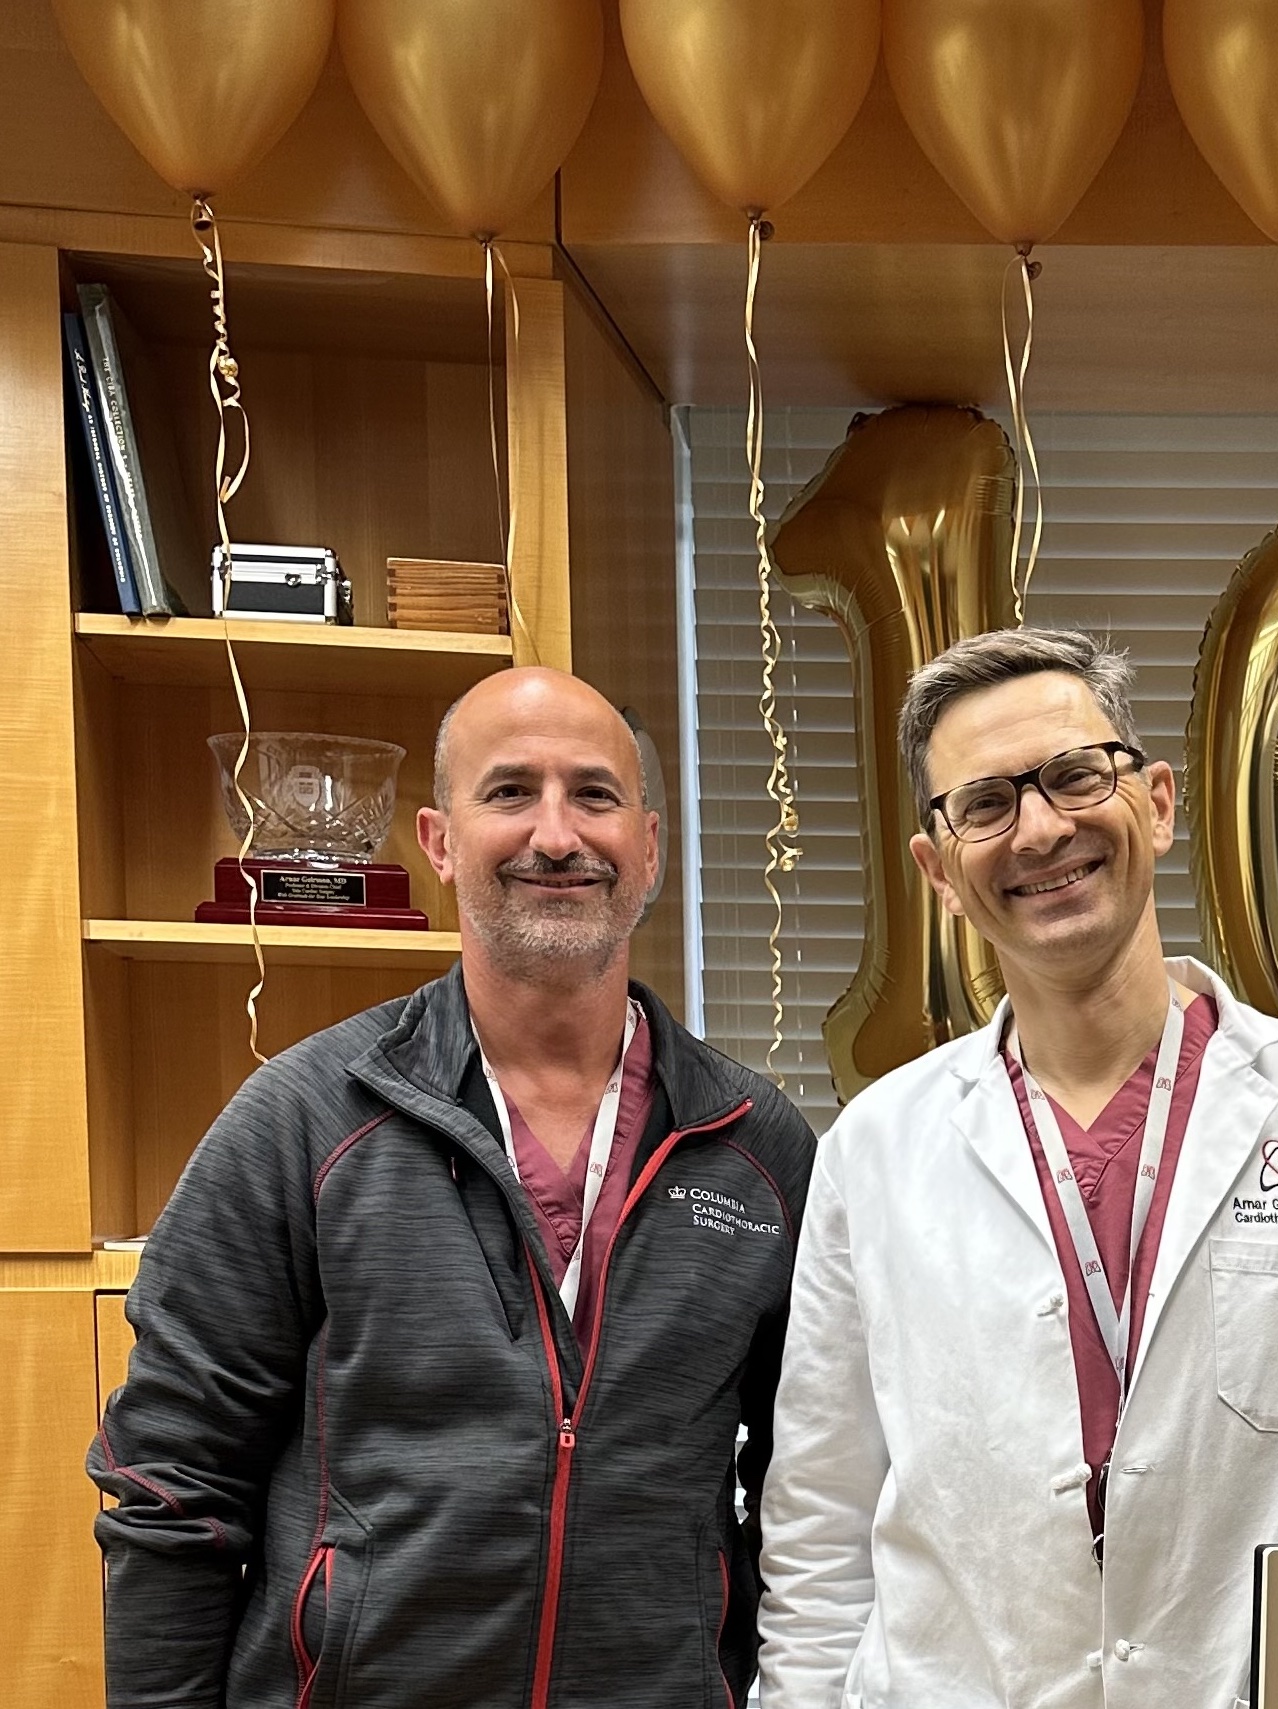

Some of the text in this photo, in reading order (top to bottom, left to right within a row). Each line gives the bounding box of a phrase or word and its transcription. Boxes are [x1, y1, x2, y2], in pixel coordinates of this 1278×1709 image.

[110, 400, 126, 451] COLLECTION
[690, 1188, 746, 1214] COLUMBIA
[692, 1203, 780, 1235] CARDIOTHORACIC
[693, 1214, 736, 1236] SURGERY
